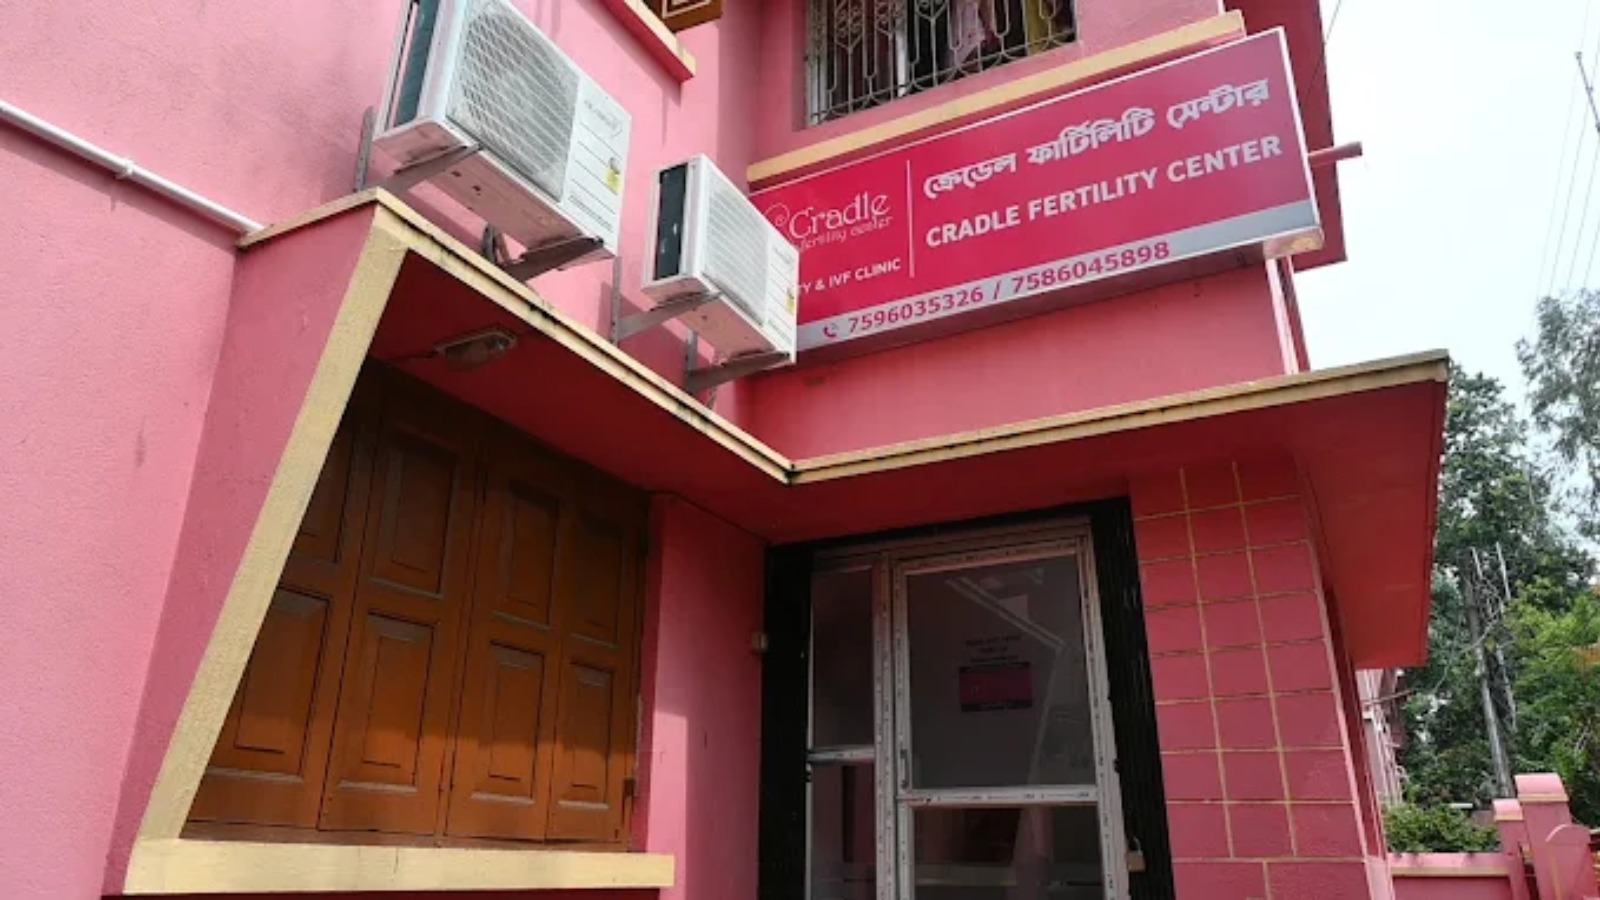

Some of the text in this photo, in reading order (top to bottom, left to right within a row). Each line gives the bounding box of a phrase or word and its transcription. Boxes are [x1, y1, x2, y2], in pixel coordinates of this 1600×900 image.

[923, 79, 1269, 199] ক্রেডেল ফার্টিলিটি সেন্টার
[789, 191, 891, 240] Cradle
[850, 216, 893, 237] center
[926, 135, 1283, 247] CRADLE FERTILITY CENTER
[815, 278, 826, 291] &
[829, 270, 852, 289] IVF
[855, 258, 902, 281] CLINIC
[848, 286, 984, 334] 7596035326
[993, 281, 1002, 301] /
[1012, 241, 1171, 295] 7586045898
